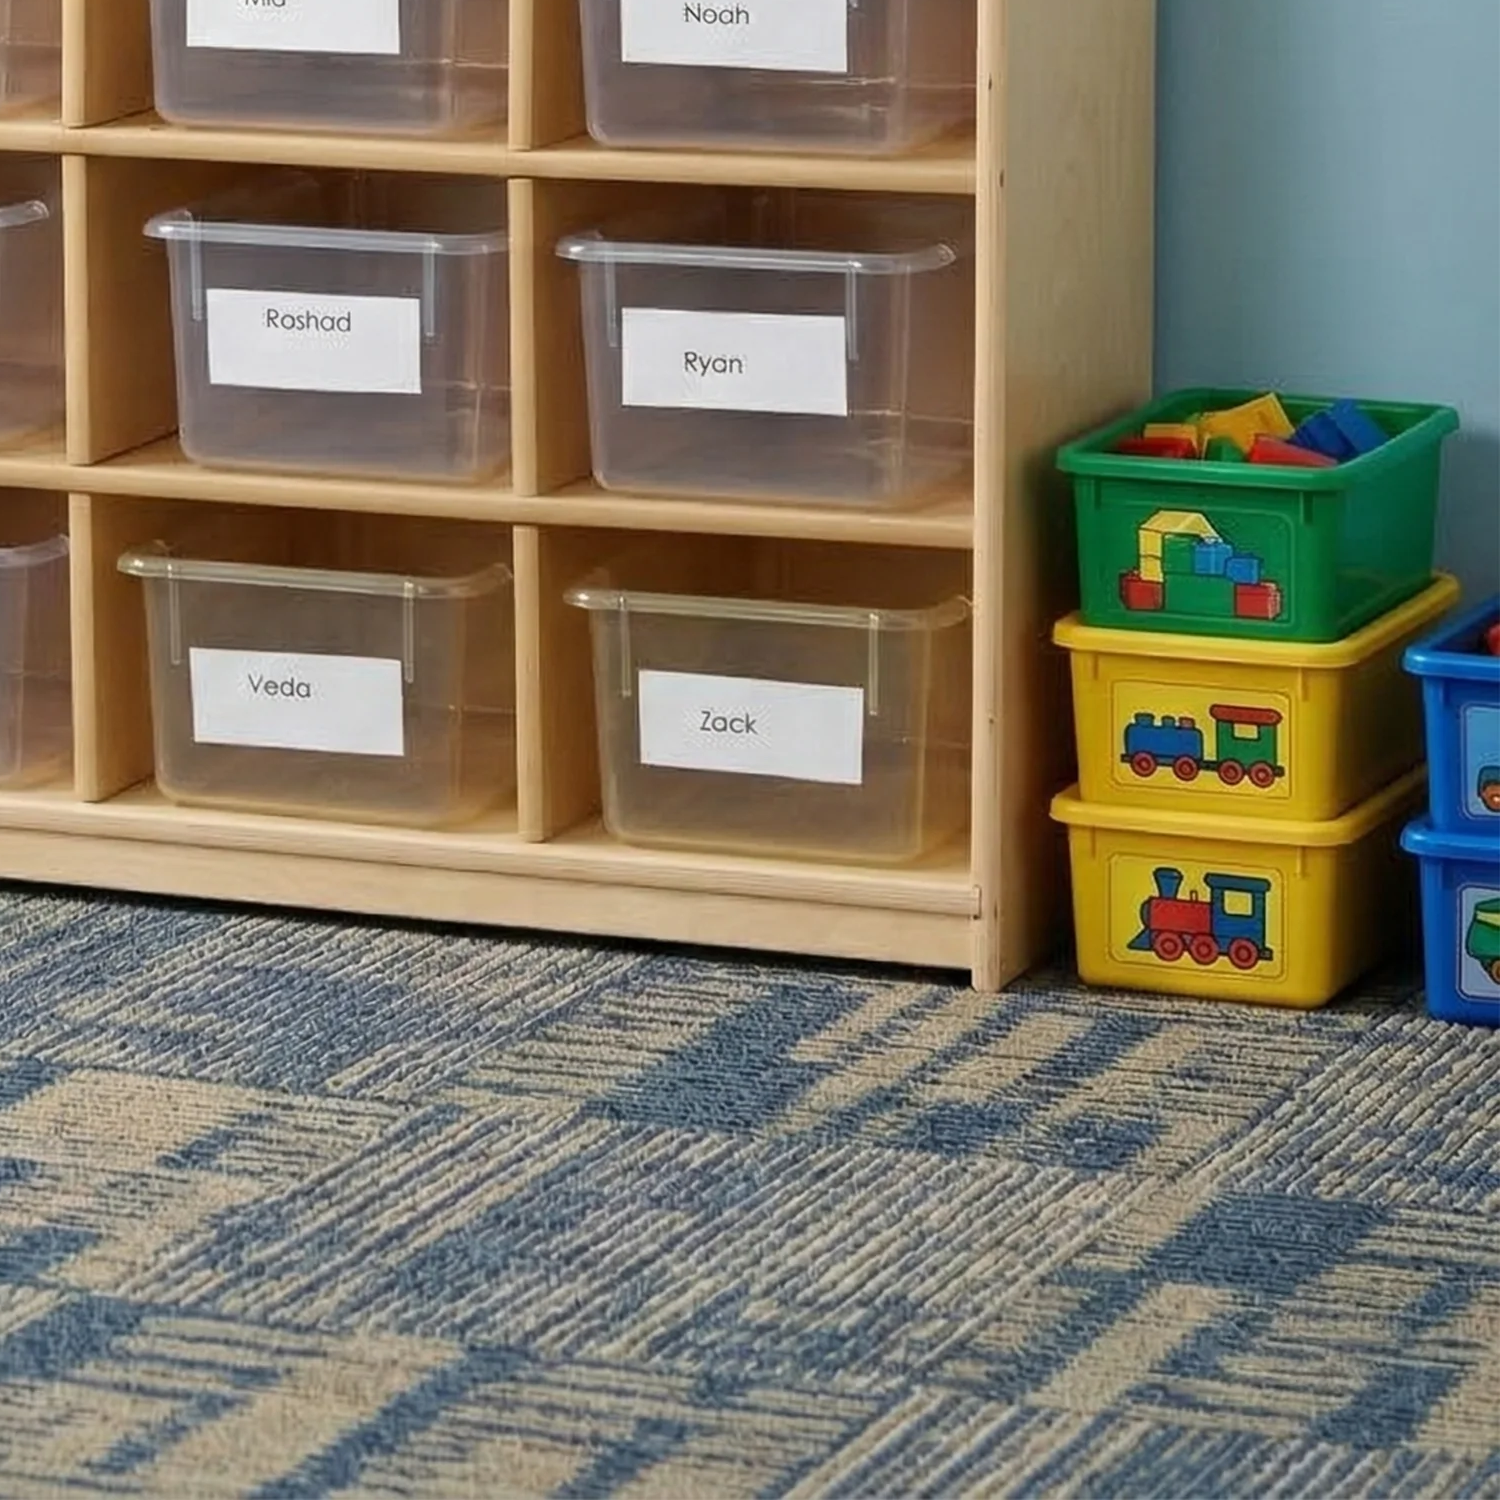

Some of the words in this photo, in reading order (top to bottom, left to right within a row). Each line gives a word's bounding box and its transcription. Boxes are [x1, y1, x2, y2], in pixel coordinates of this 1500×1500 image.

[683, 2, 750, 26] Noah
[683, 351, 743, 377] Ryan
[247, 673, 312, 699] Veda
[699, 710, 758, 735] Zack
